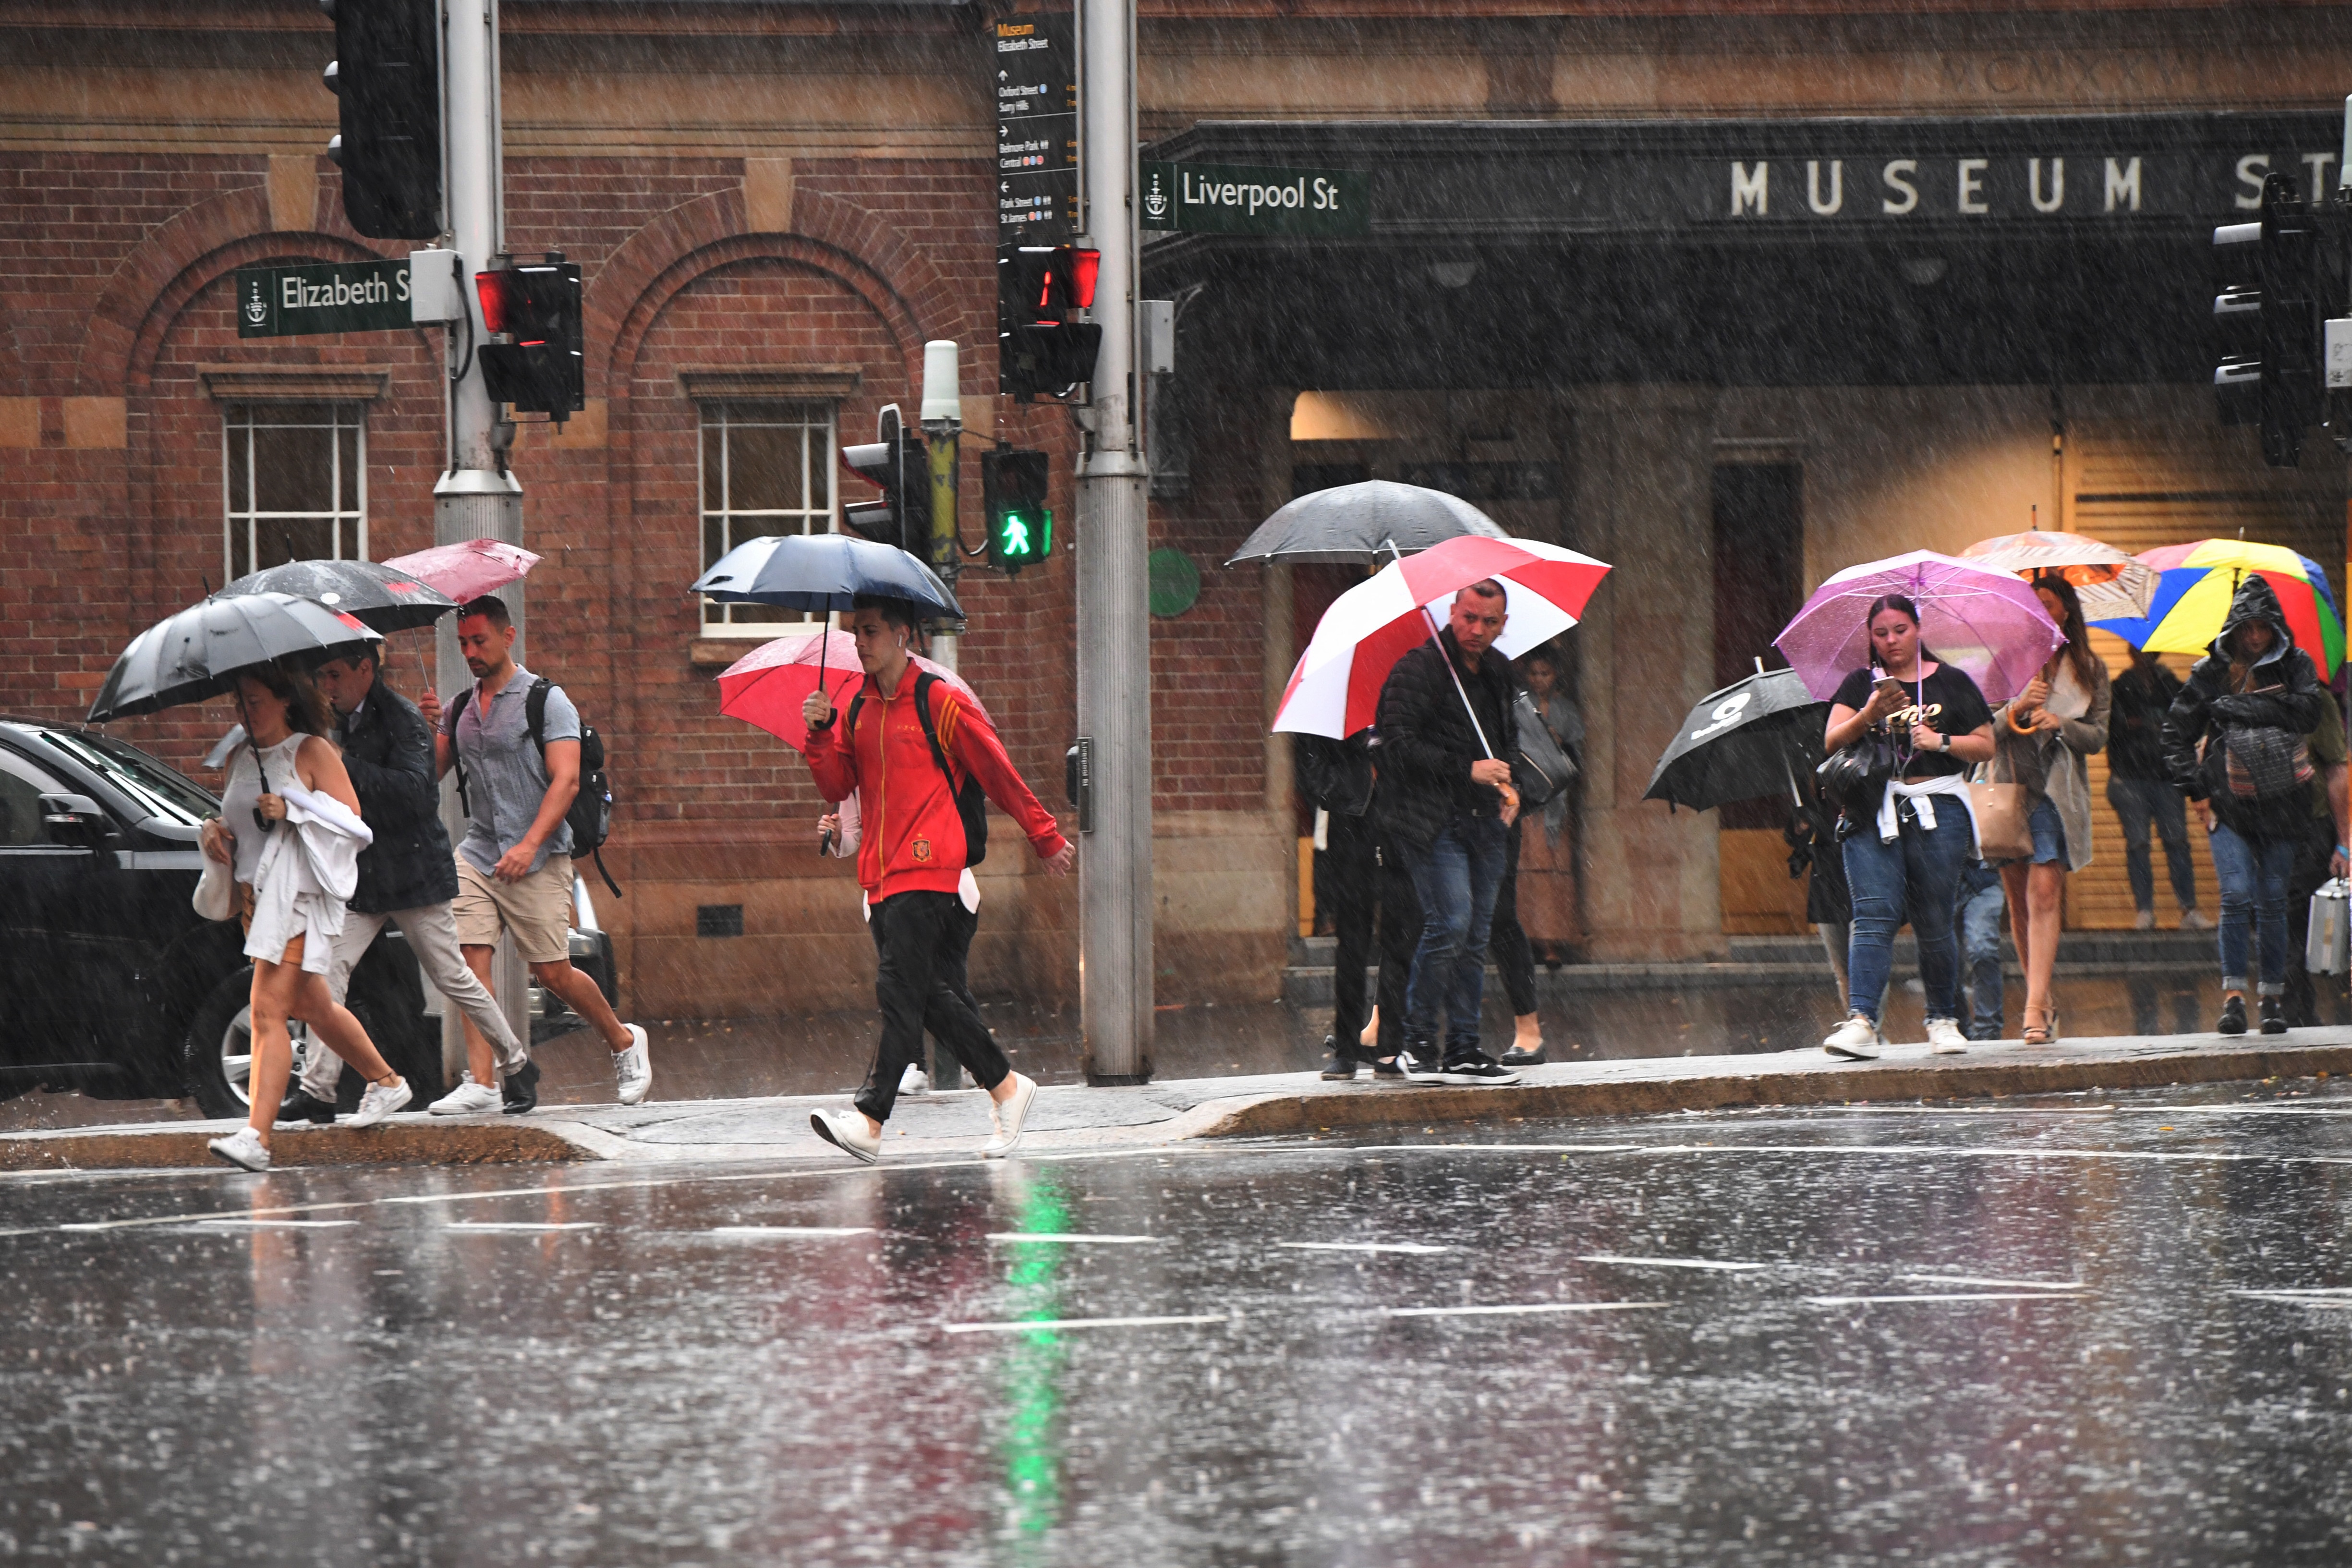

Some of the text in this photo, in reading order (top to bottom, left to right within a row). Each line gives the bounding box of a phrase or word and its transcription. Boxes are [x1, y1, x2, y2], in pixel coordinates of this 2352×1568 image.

[997, 24, 1034, 37] Museum
[1028, 38, 1049, 49] Street
[1020, 85, 1039, 95] Street
[1016, 100, 1030, 110] Hills
[1024, 140, 1039, 151] Park
[999, 157, 1022, 168] Central
[1731, 157, 2141, 216] MUSEUM
[1183, 172, 1339, 216] Liverpool St
[1014, 197, 1033, 207] Street
[1008, 213, 1028, 223] James
[282, 269, 412, 308] Elizabeth S
